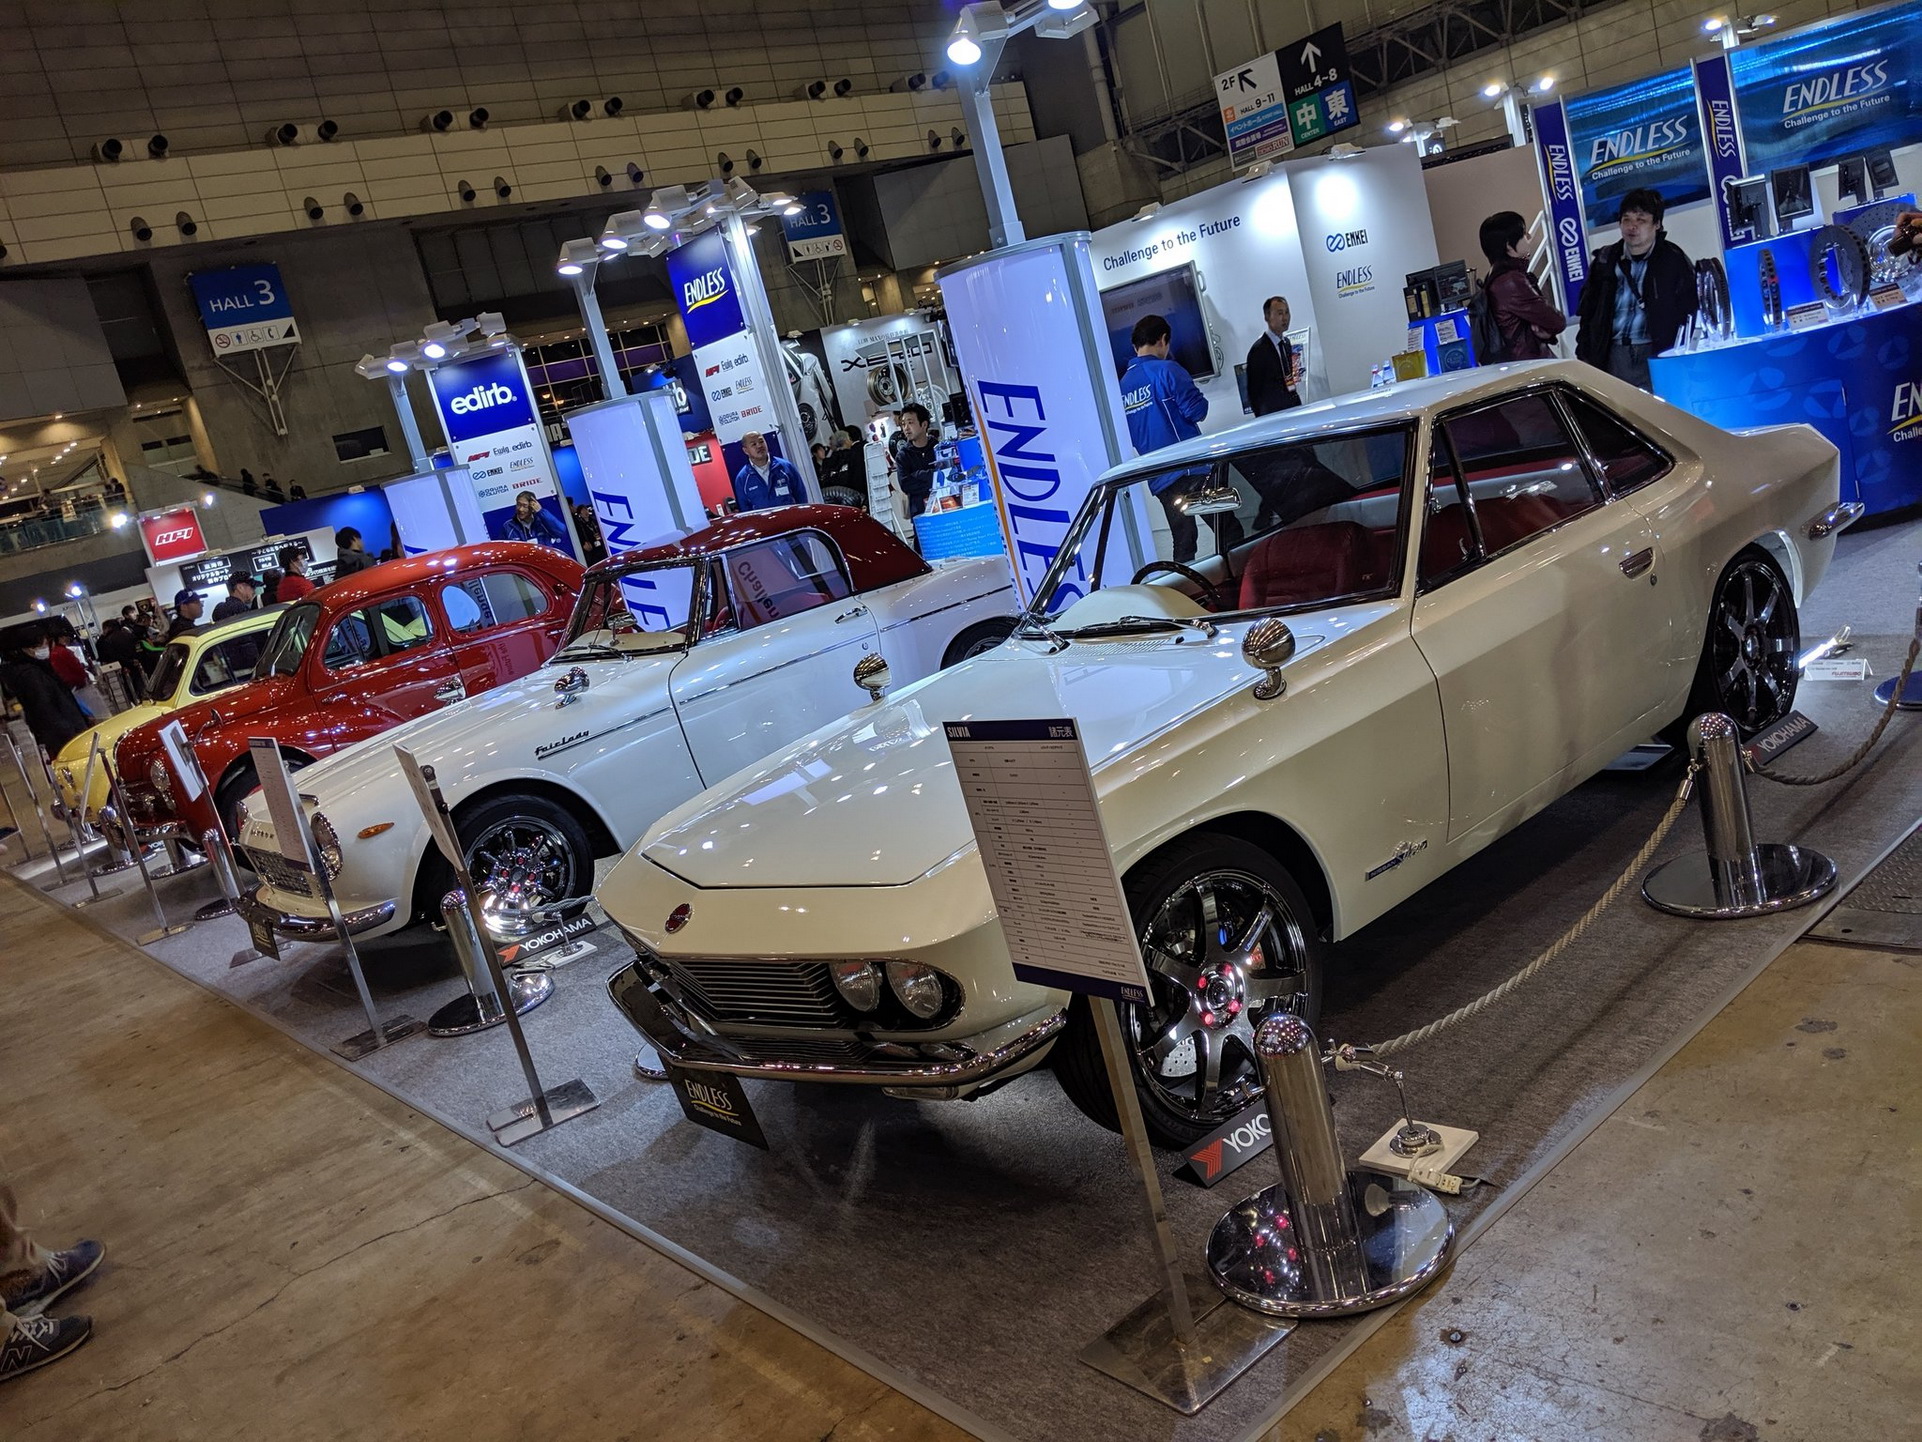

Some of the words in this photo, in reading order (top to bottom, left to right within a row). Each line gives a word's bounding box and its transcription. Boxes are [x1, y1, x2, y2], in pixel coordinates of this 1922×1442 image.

[1221, 75, 1236, 91] 2F
[1295, 83, 1314, 96] HALL
[1783, 59, 1888, 113] ENDLESS
[1241, 105, 1255, 115] HALL
[1296, 103, 1317, 130] 中
[1325, 88, 1349, 120] 東
[1784, 112, 1828, 129] Challenge
[1831, 108, 1840, 116] to
[1842, 103, 1858, 113] the
[1860, 95, 1890, 109] Future
[1301, 128, 1320, 139] CENTER
[1591, 115, 1687, 165] ENDLESS
[1712, 100, 1736, 158] ENDLESS
[1548, 144, 1574, 201] ENDLESS
[1592, 164, 1633, 180] Challenge
[1635, 161, 1644, 169] to
[1646, 156, 1660, 166] the
[1662, 149, 1690, 162] Future
[789, 215, 818, 228] HALL
[817, 204, 831, 224] 3
[1103, 244, 1159, 271] Challenge
[1161, 239, 1174, 251] to
[1176, 231, 1197, 246] the
[1199, 216, 1240, 239] Future
[1345, 229, 1368, 248] ENKEI
[1336, 264, 1372, 289] ENDLESS
[1564, 246, 1584, 282] ENKEI
[209, 295, 254, 312] HALL
[254, 280, 275, 305] 3
[683, 267, 725, 306] ENDLESS
[741, 405, 763, 418] BRIDE
[512, 477, 543, 489] BRIDE
[155, 527, 194, 546] HPI
[947, 726, 971, 737] SILVIA
[1756, 716, 1811, 753] YOKOHAMA
[520, 918, 592, 952] YOKOHAMA
[685, 1079, 732, 1110] ENDLESS
